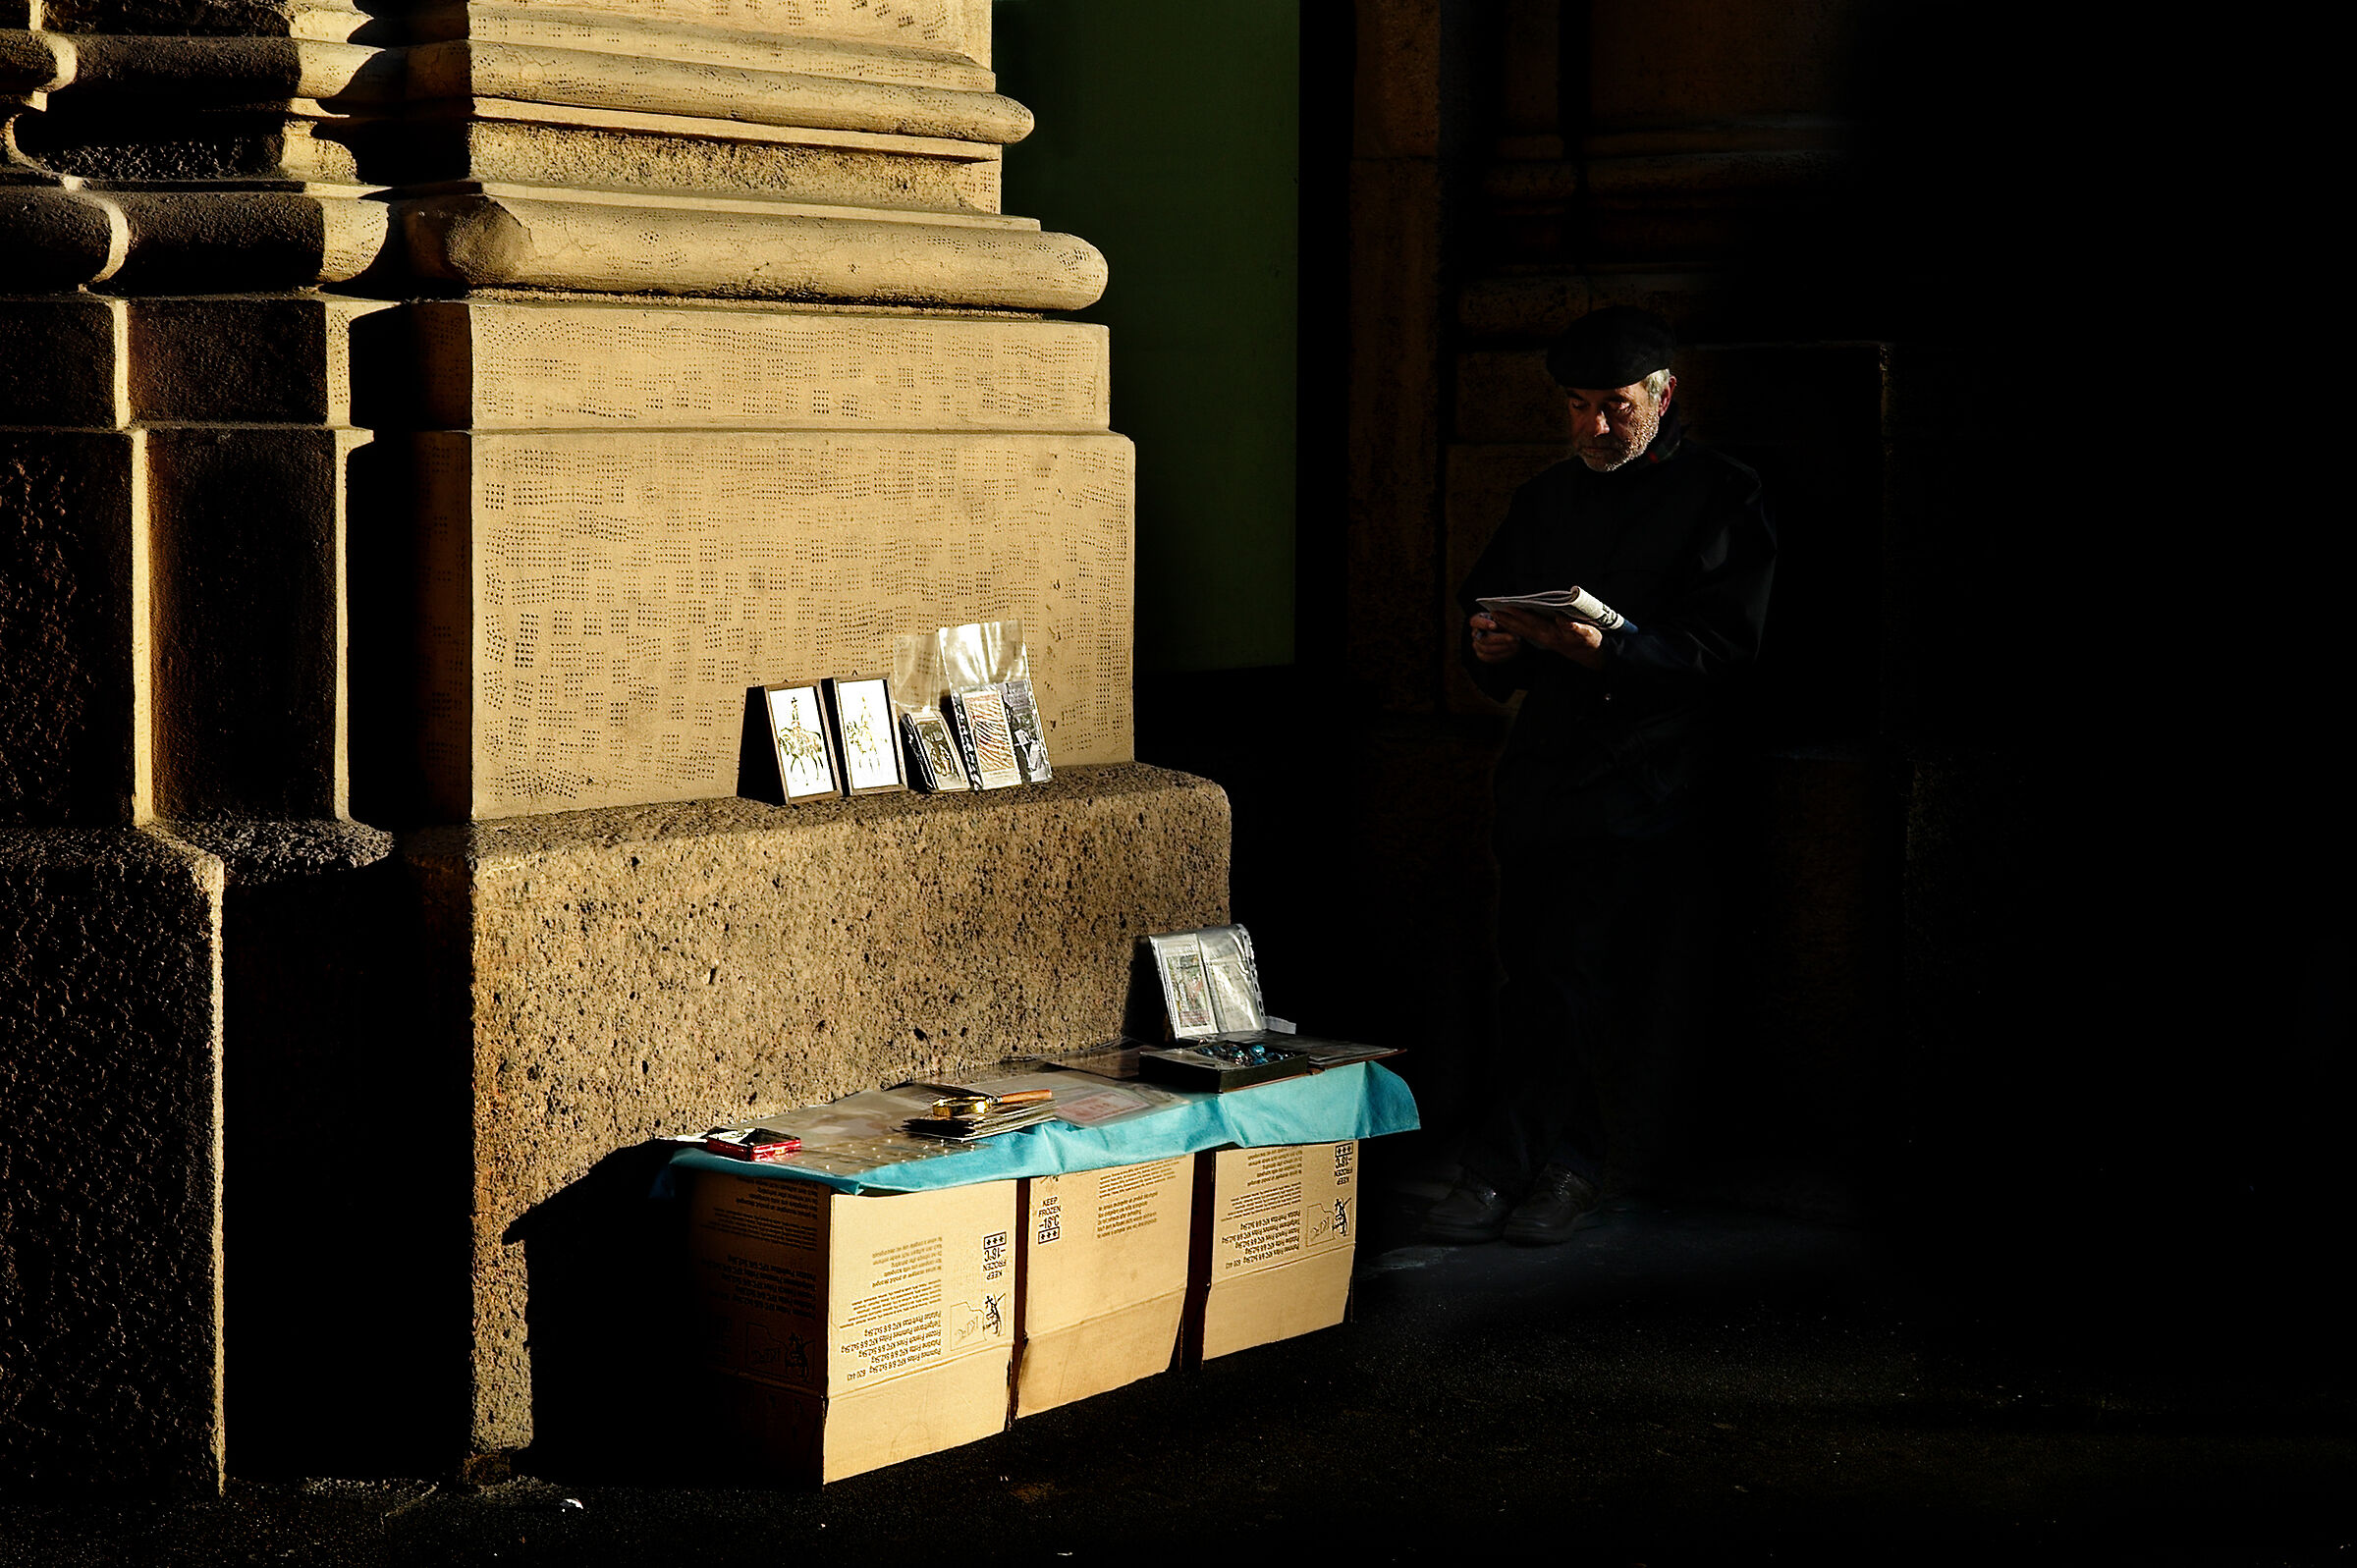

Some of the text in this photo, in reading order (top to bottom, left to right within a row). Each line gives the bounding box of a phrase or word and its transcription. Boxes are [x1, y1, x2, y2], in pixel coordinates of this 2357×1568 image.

[1043, 1197, 1058, 1207] KEEP
[1038, 1206, 1061, 1217] FROZEN
[983, 1260, 1006, 1271] FROZEN
[987, 1271, 1002, 1279] KEEP
[892, 1321, 901, 1329] KFC
[868, 1336, 877, 1346] KFC
[886, 1341, 895, 1351] KFC
[899, 1347, 907, 1356] KFC
[897, 1357, 905, 1367] KFC
